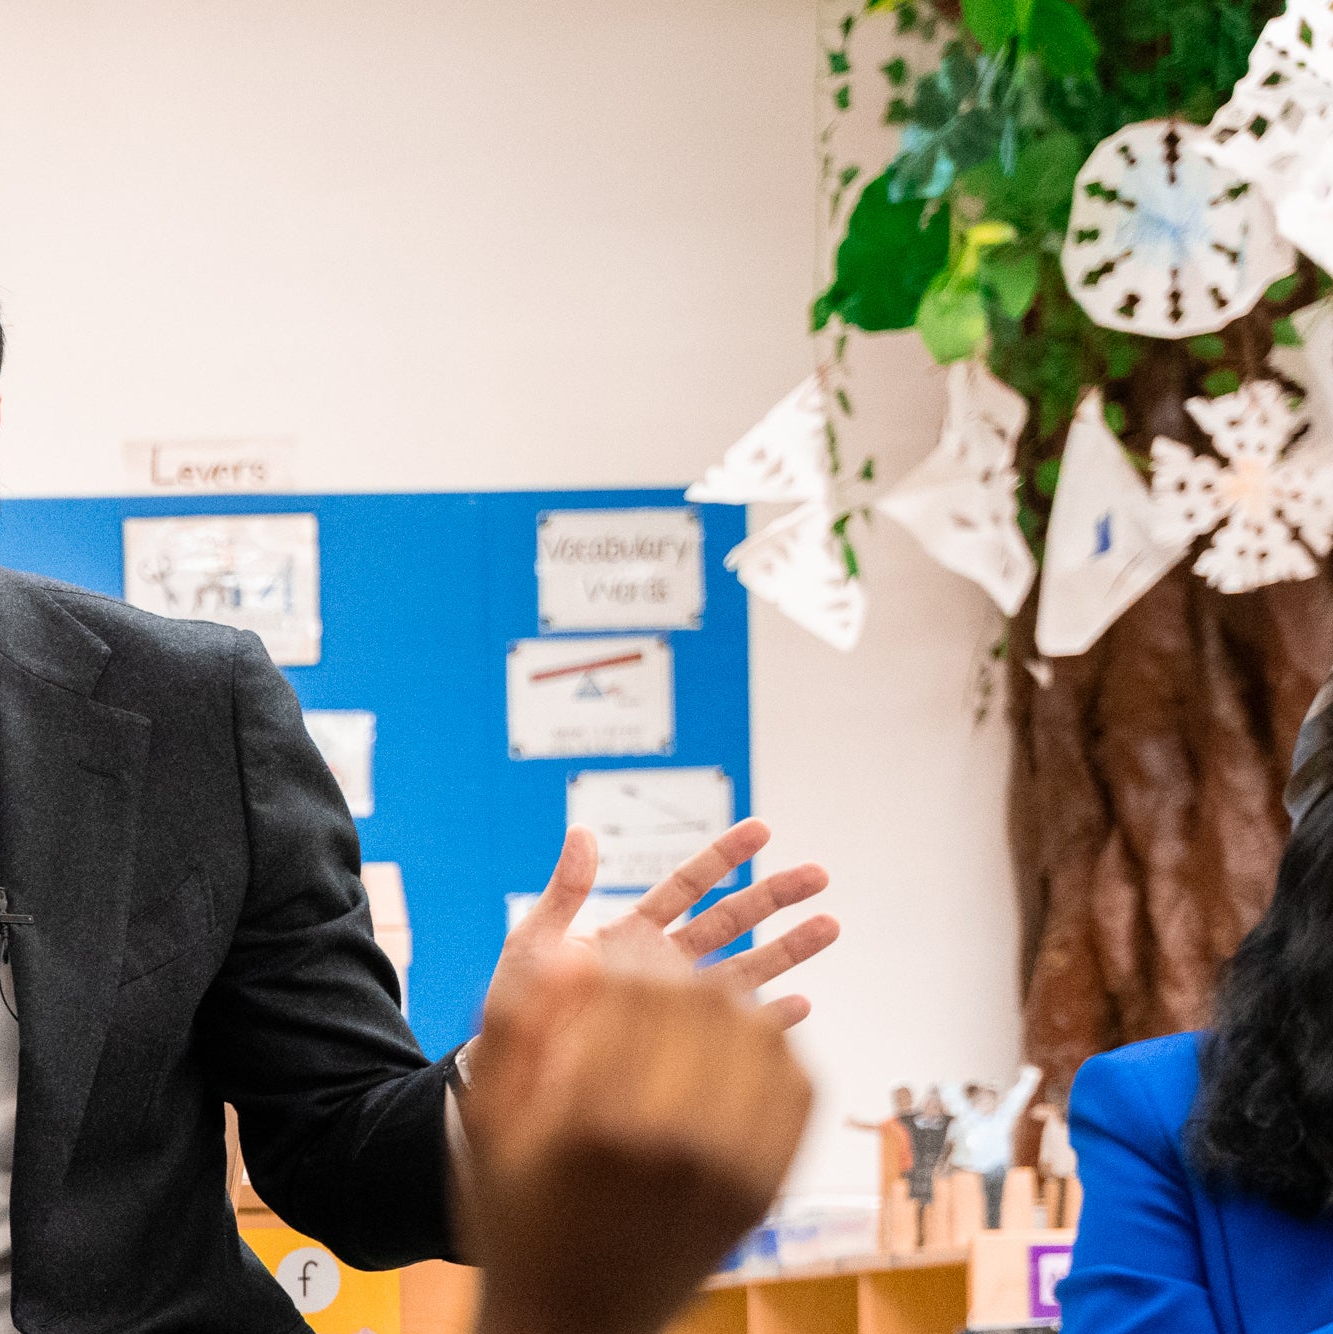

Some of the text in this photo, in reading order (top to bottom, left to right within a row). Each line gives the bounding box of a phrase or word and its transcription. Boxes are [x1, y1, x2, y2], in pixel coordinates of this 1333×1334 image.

[150, 444, 265, 486] Levers
[543, 533, 693, 568] Vocabulary
[297, 1260, 318, 1297] f
